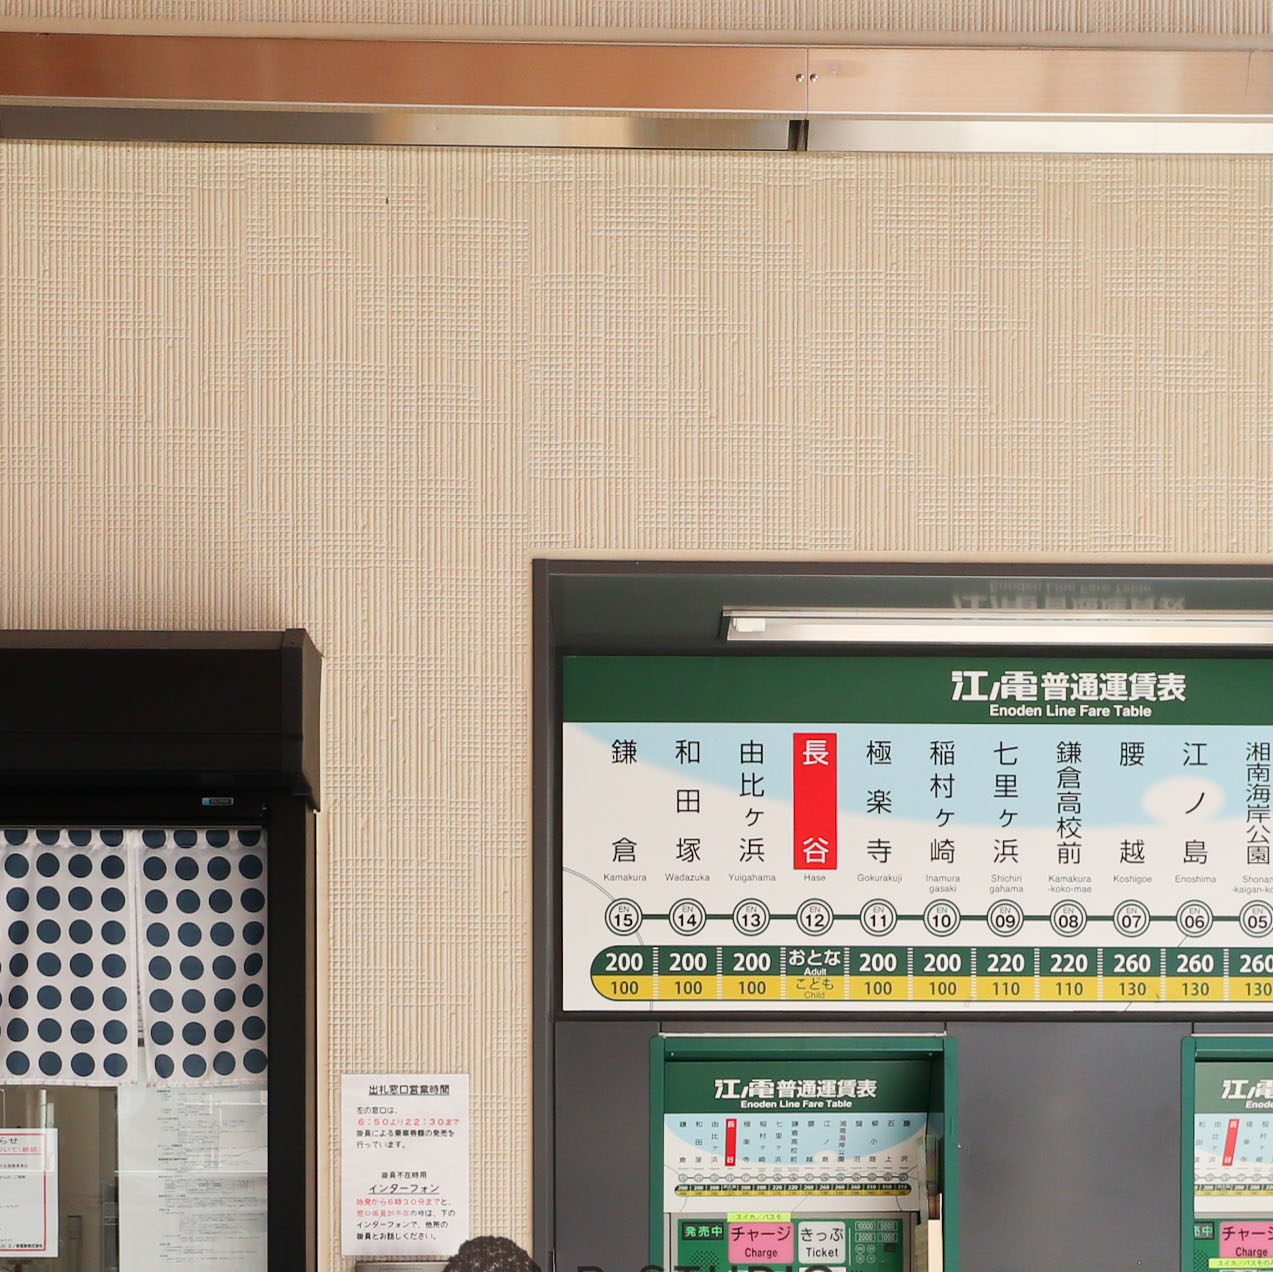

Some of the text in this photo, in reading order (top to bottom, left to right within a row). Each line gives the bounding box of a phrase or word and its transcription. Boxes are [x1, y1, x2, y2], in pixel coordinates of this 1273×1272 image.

[990, 704, 1152, 716] Enoden Line Fare Table
[611, 739, 637, 863] 鎌倉
[675, 739, 701, 863] 和田塚
[802, 739, 829, 863] 長谷
[866, 739, 892, 863] 極楽寺
[1057, 741, 1082, 865] 鎌倉高校前
[1119, 741, 1145, 865] 腰越
[1183, 741, 1208, 865] 江ノ島
[1246, 741, 1271, 865] 湘南海岸公園
[604, 873, 646, 881] Kamakura
[665, 873, 709, 881] Wadazuka
[729, 874, 776, 883] Yuigahama
[857, 874, 902, 883] Gokurakuji
[991, 874, 1023, 883] Shichiri
[1049, 875, 1091, 886] Kamakura
[1113, 875, 1152, 885] Koshigoe
[1175, 875, 1216, 883] Enoshima
[929, 885, 956, 894] gasaki
[989, 885, 1023, 894] gahama
[613, 913, 634, 927] 15
[677, 913, 697, 927] 14
[741, 913, 761, 927] 13
[804, 913, 825, 927] 12
[868, 913, 888, 927] 11
[931, 913, 952, 927] 10
[995, 913, 1015, 927] 09
[1059, 916, 1079, 929] 08
[605, 953, 643, 972] 200
[669, 953, 707, 972] 200
[733, 953, 771, 972] 200
[788, 949, 841, 967] おとな
[859, 953, 897, 972] 200
[923, 953, 961, 972] 200
[987, 953, 1024, 972] 220
[1051, 954, 1088, 974] 220
[1113, 954, 1151, 974] 260
[1177, 954, 1215, 974] 260
[804, 967, 827, 975] Adult
[795, 978, 834, 991] こども
[804, 991, 825, 999] Child
[369, 1085, 449, 1095] 出札窓口営業時間
[741, 1100, 852, 1108] Enoden Line Fare Table
[369, 1184, 439, 1194] インターフォン
[685, 1226, 722, 1238] 発売中
[731, 1226, 791, 1242] チャージ
[801, 1227, 843, 1242] きっぷ
[745, 1248, 777, 1259] Charge
[806, 1248, 838, 1257] Ticket
[1235, 1247, 1268, 1258] Charge
